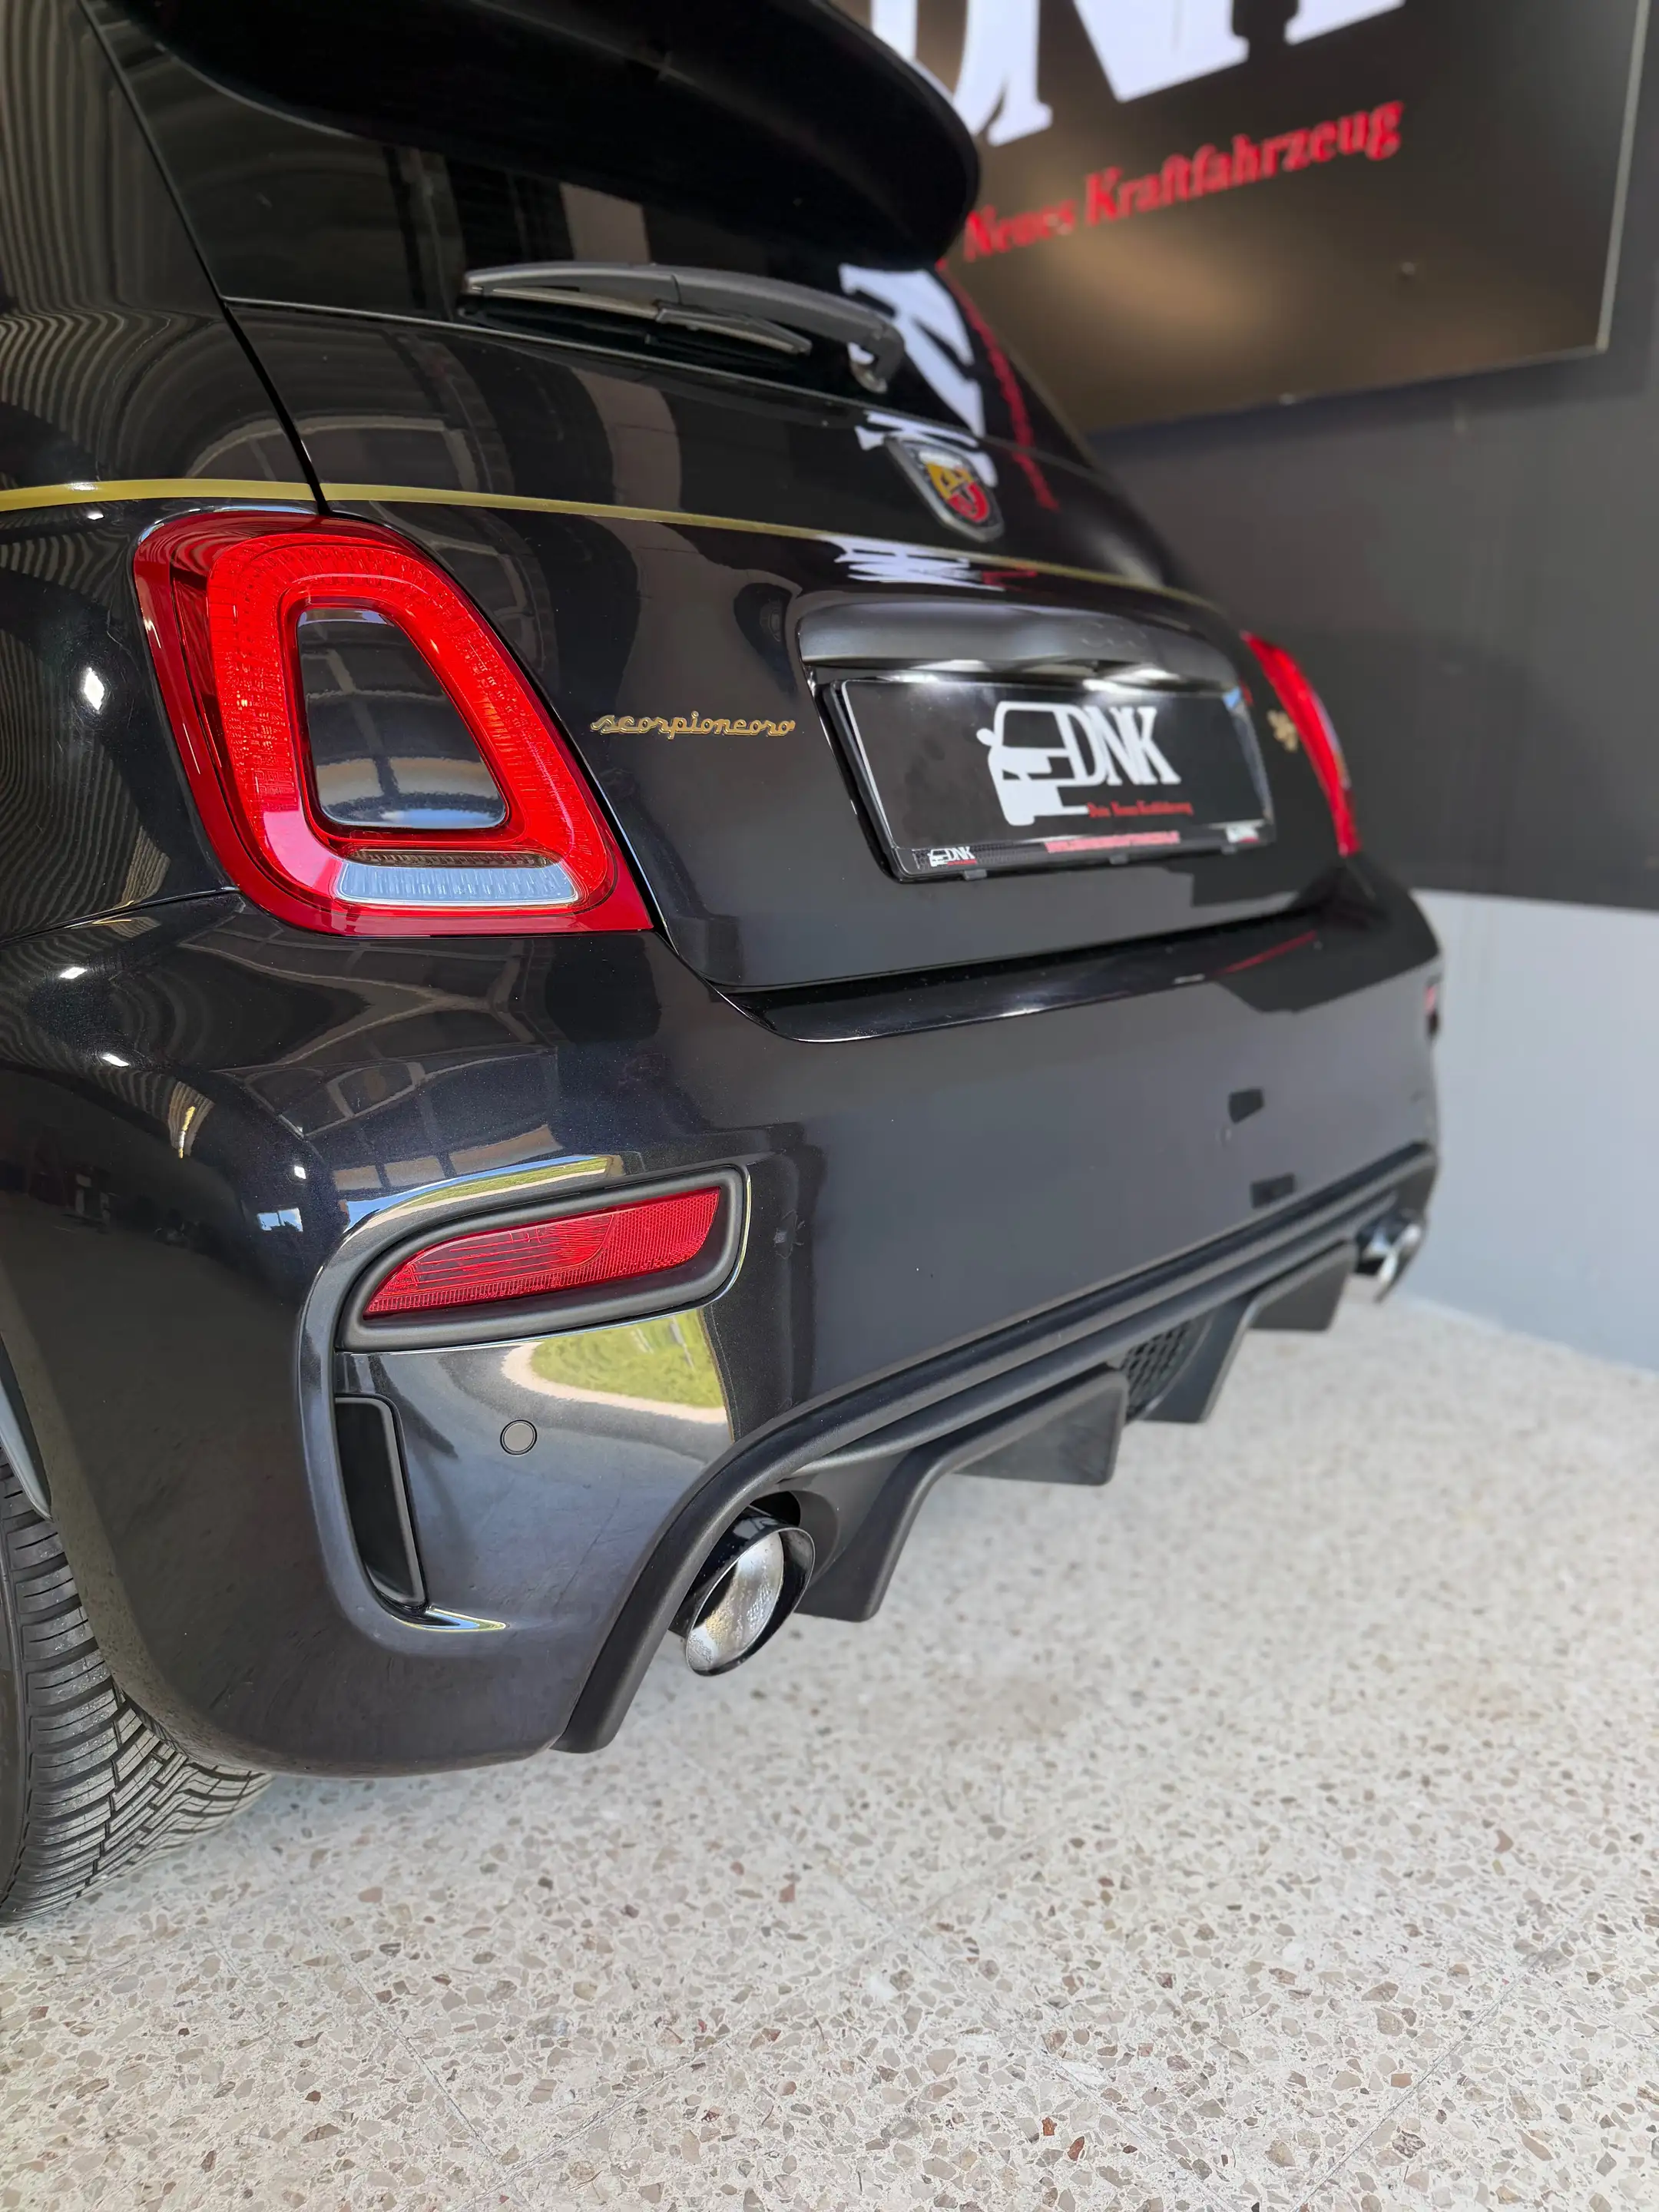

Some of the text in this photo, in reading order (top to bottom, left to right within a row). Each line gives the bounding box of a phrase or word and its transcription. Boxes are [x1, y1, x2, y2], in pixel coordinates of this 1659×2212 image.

[1084, 101, 1404, 227] Kraftfahrzeug
[590, 710, 796, 740] scorpioneoro
[1053, 703, 1182, 786] DNK
[945, 846, 976, 861] DNK
